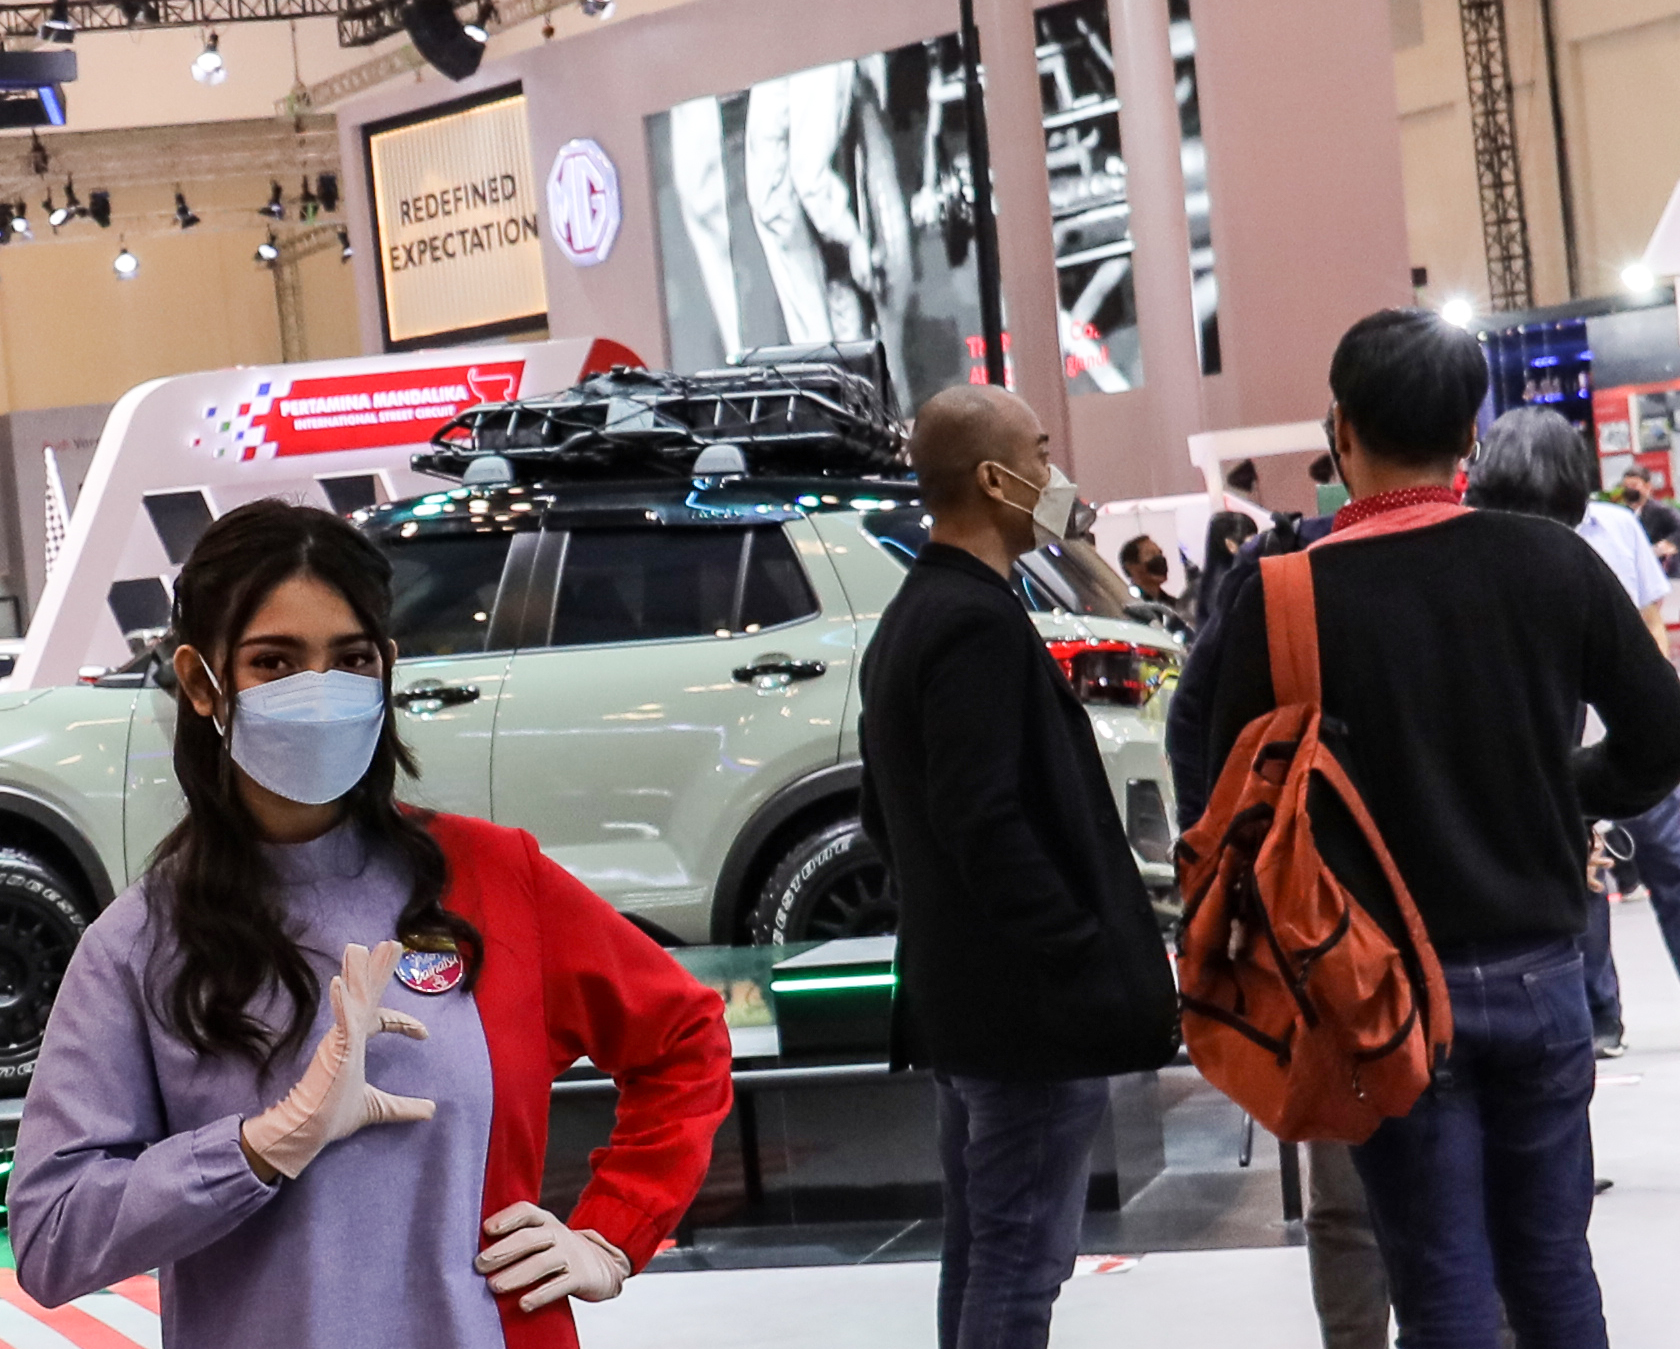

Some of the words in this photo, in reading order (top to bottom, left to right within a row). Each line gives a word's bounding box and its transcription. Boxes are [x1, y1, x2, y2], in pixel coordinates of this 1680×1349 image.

[400, 174, 516, 227] REDEFINED
[390, 214, 539, 272] EXPECTATION
[280, 395, 373, 417] PERTAMINA
[376, 385, 470, 410] MANDALIKA
[293, 411, 377, 431] INTERNATIONAL
[378, 408, 414, 424] STREET
[415, 405, 456, 421] CIRCUIT
